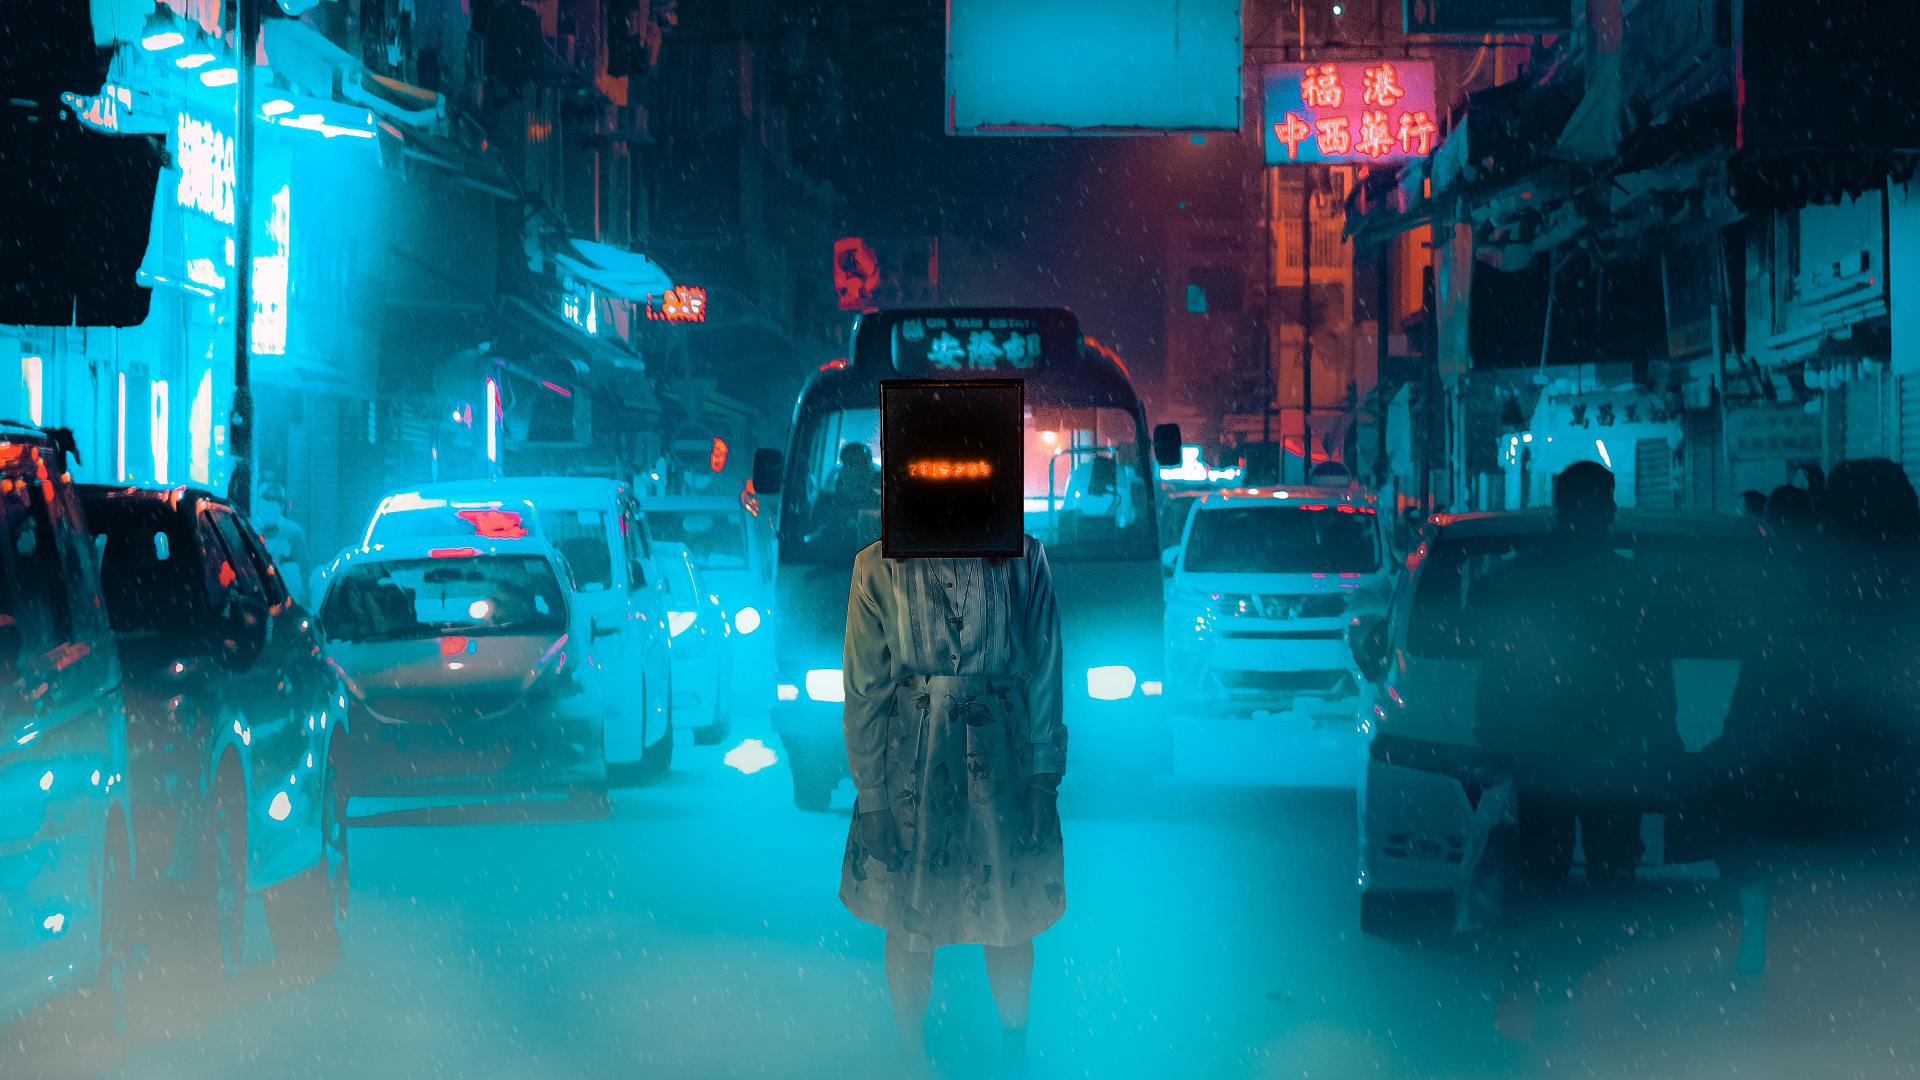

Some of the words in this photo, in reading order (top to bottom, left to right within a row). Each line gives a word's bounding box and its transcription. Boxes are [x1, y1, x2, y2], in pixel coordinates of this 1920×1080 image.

[1301, 63, 1405, 108] 福港
[1274, 110, 1437, 159] 中西藥行
